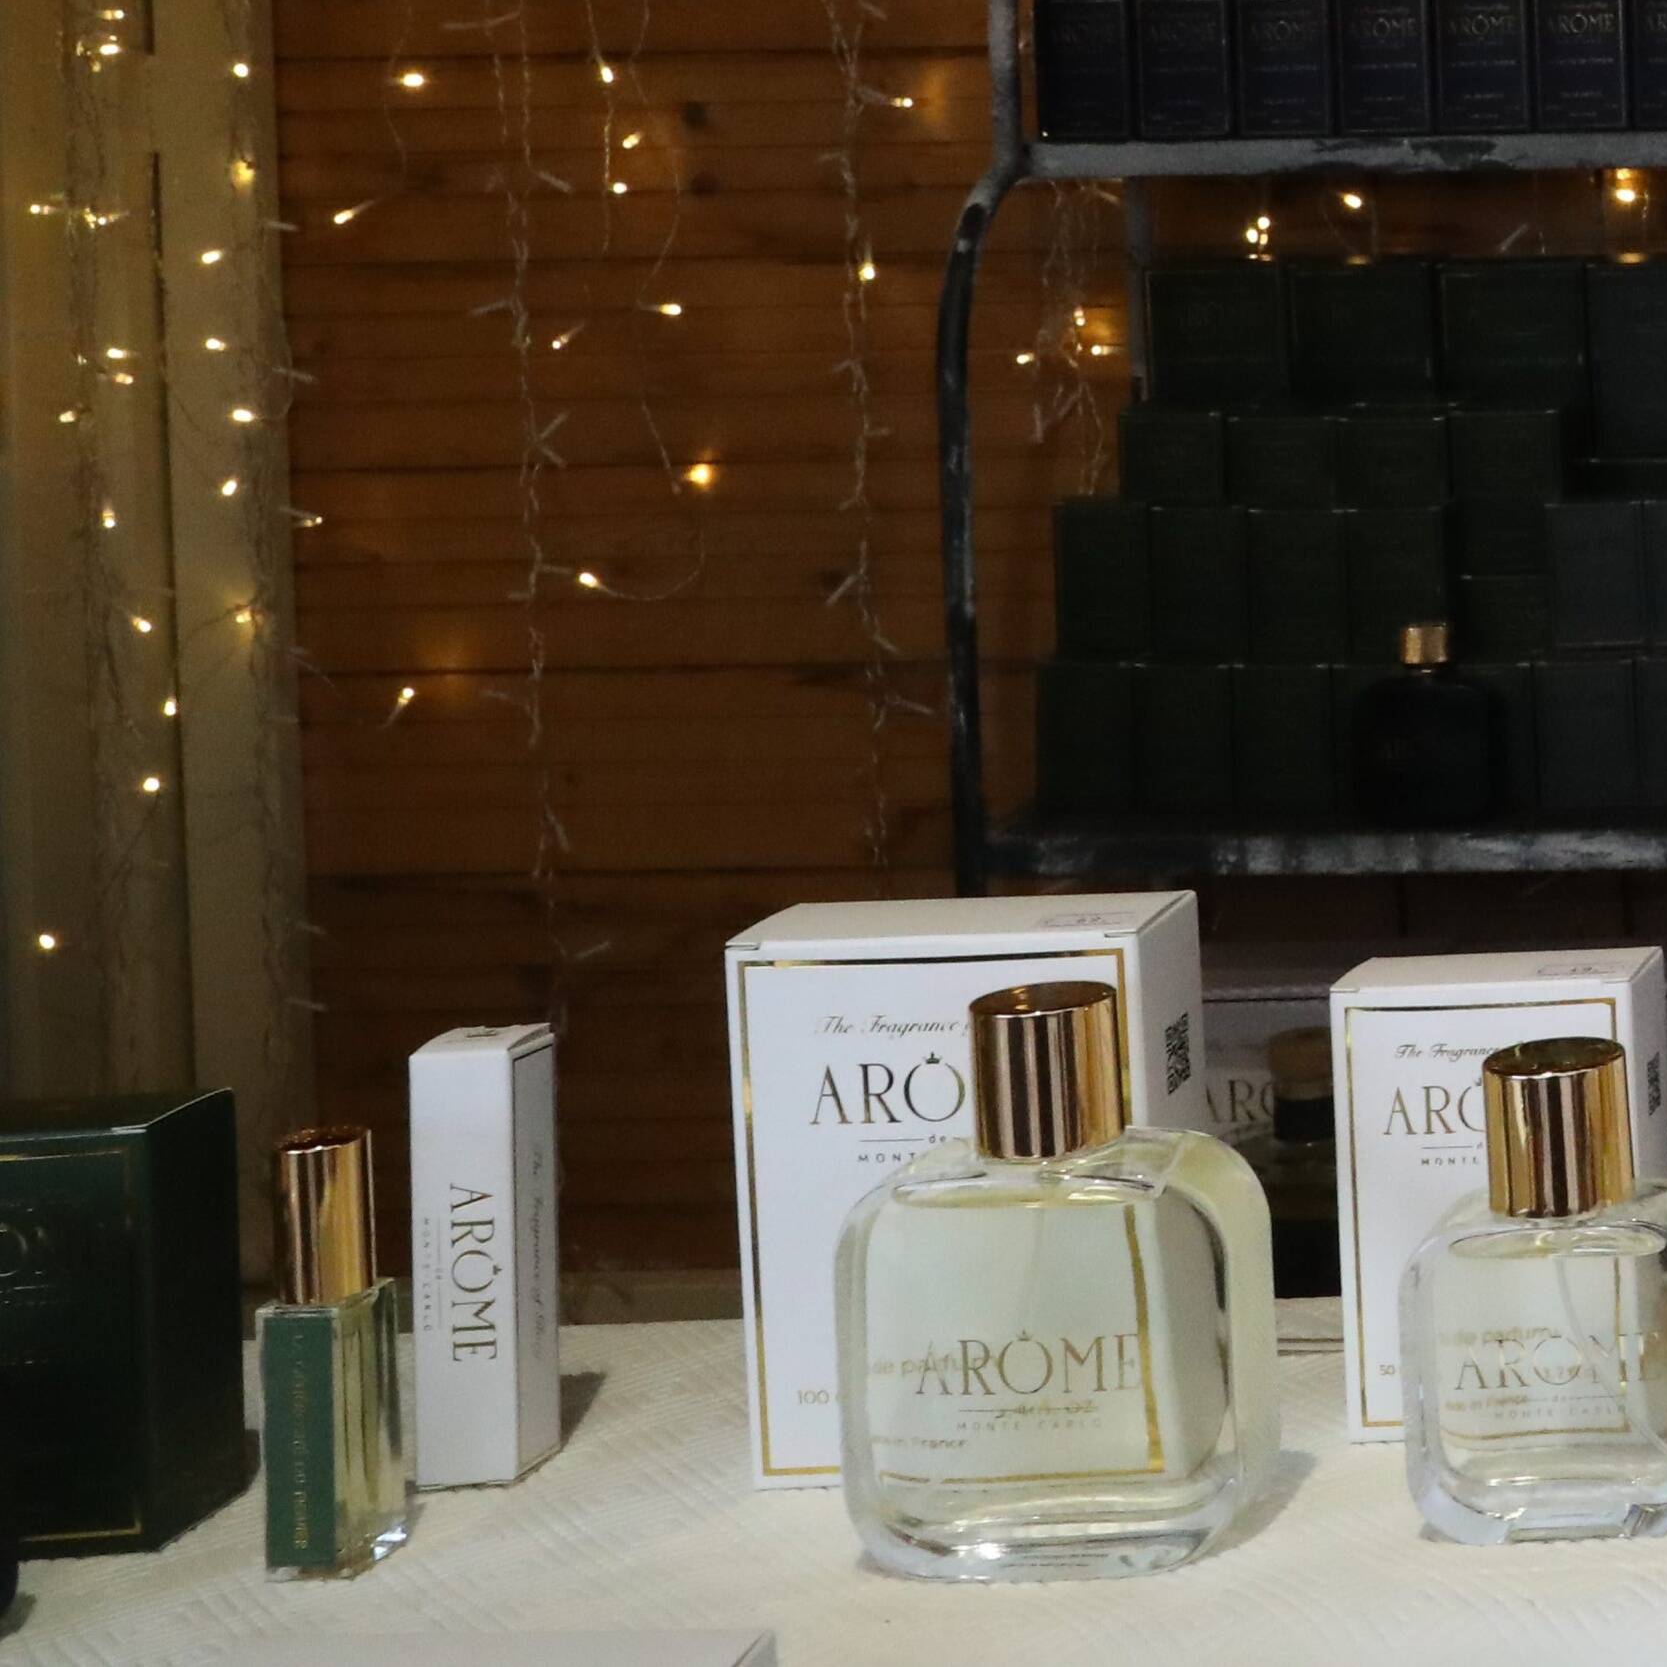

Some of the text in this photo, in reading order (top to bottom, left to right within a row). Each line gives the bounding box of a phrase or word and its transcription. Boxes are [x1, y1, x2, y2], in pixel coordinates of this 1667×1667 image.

[814, 1015, 853, 1034] The
[861, 1014, 959, 1040] Fragrance
[1395, 1044, 1422, 1058] The
[810, 1052, 966, 1124] ARO
[928, 1134, 946, 1143] de
[1379, 1365, 1395, 1376] 50
[796, 1390, 830, 1405] 100
